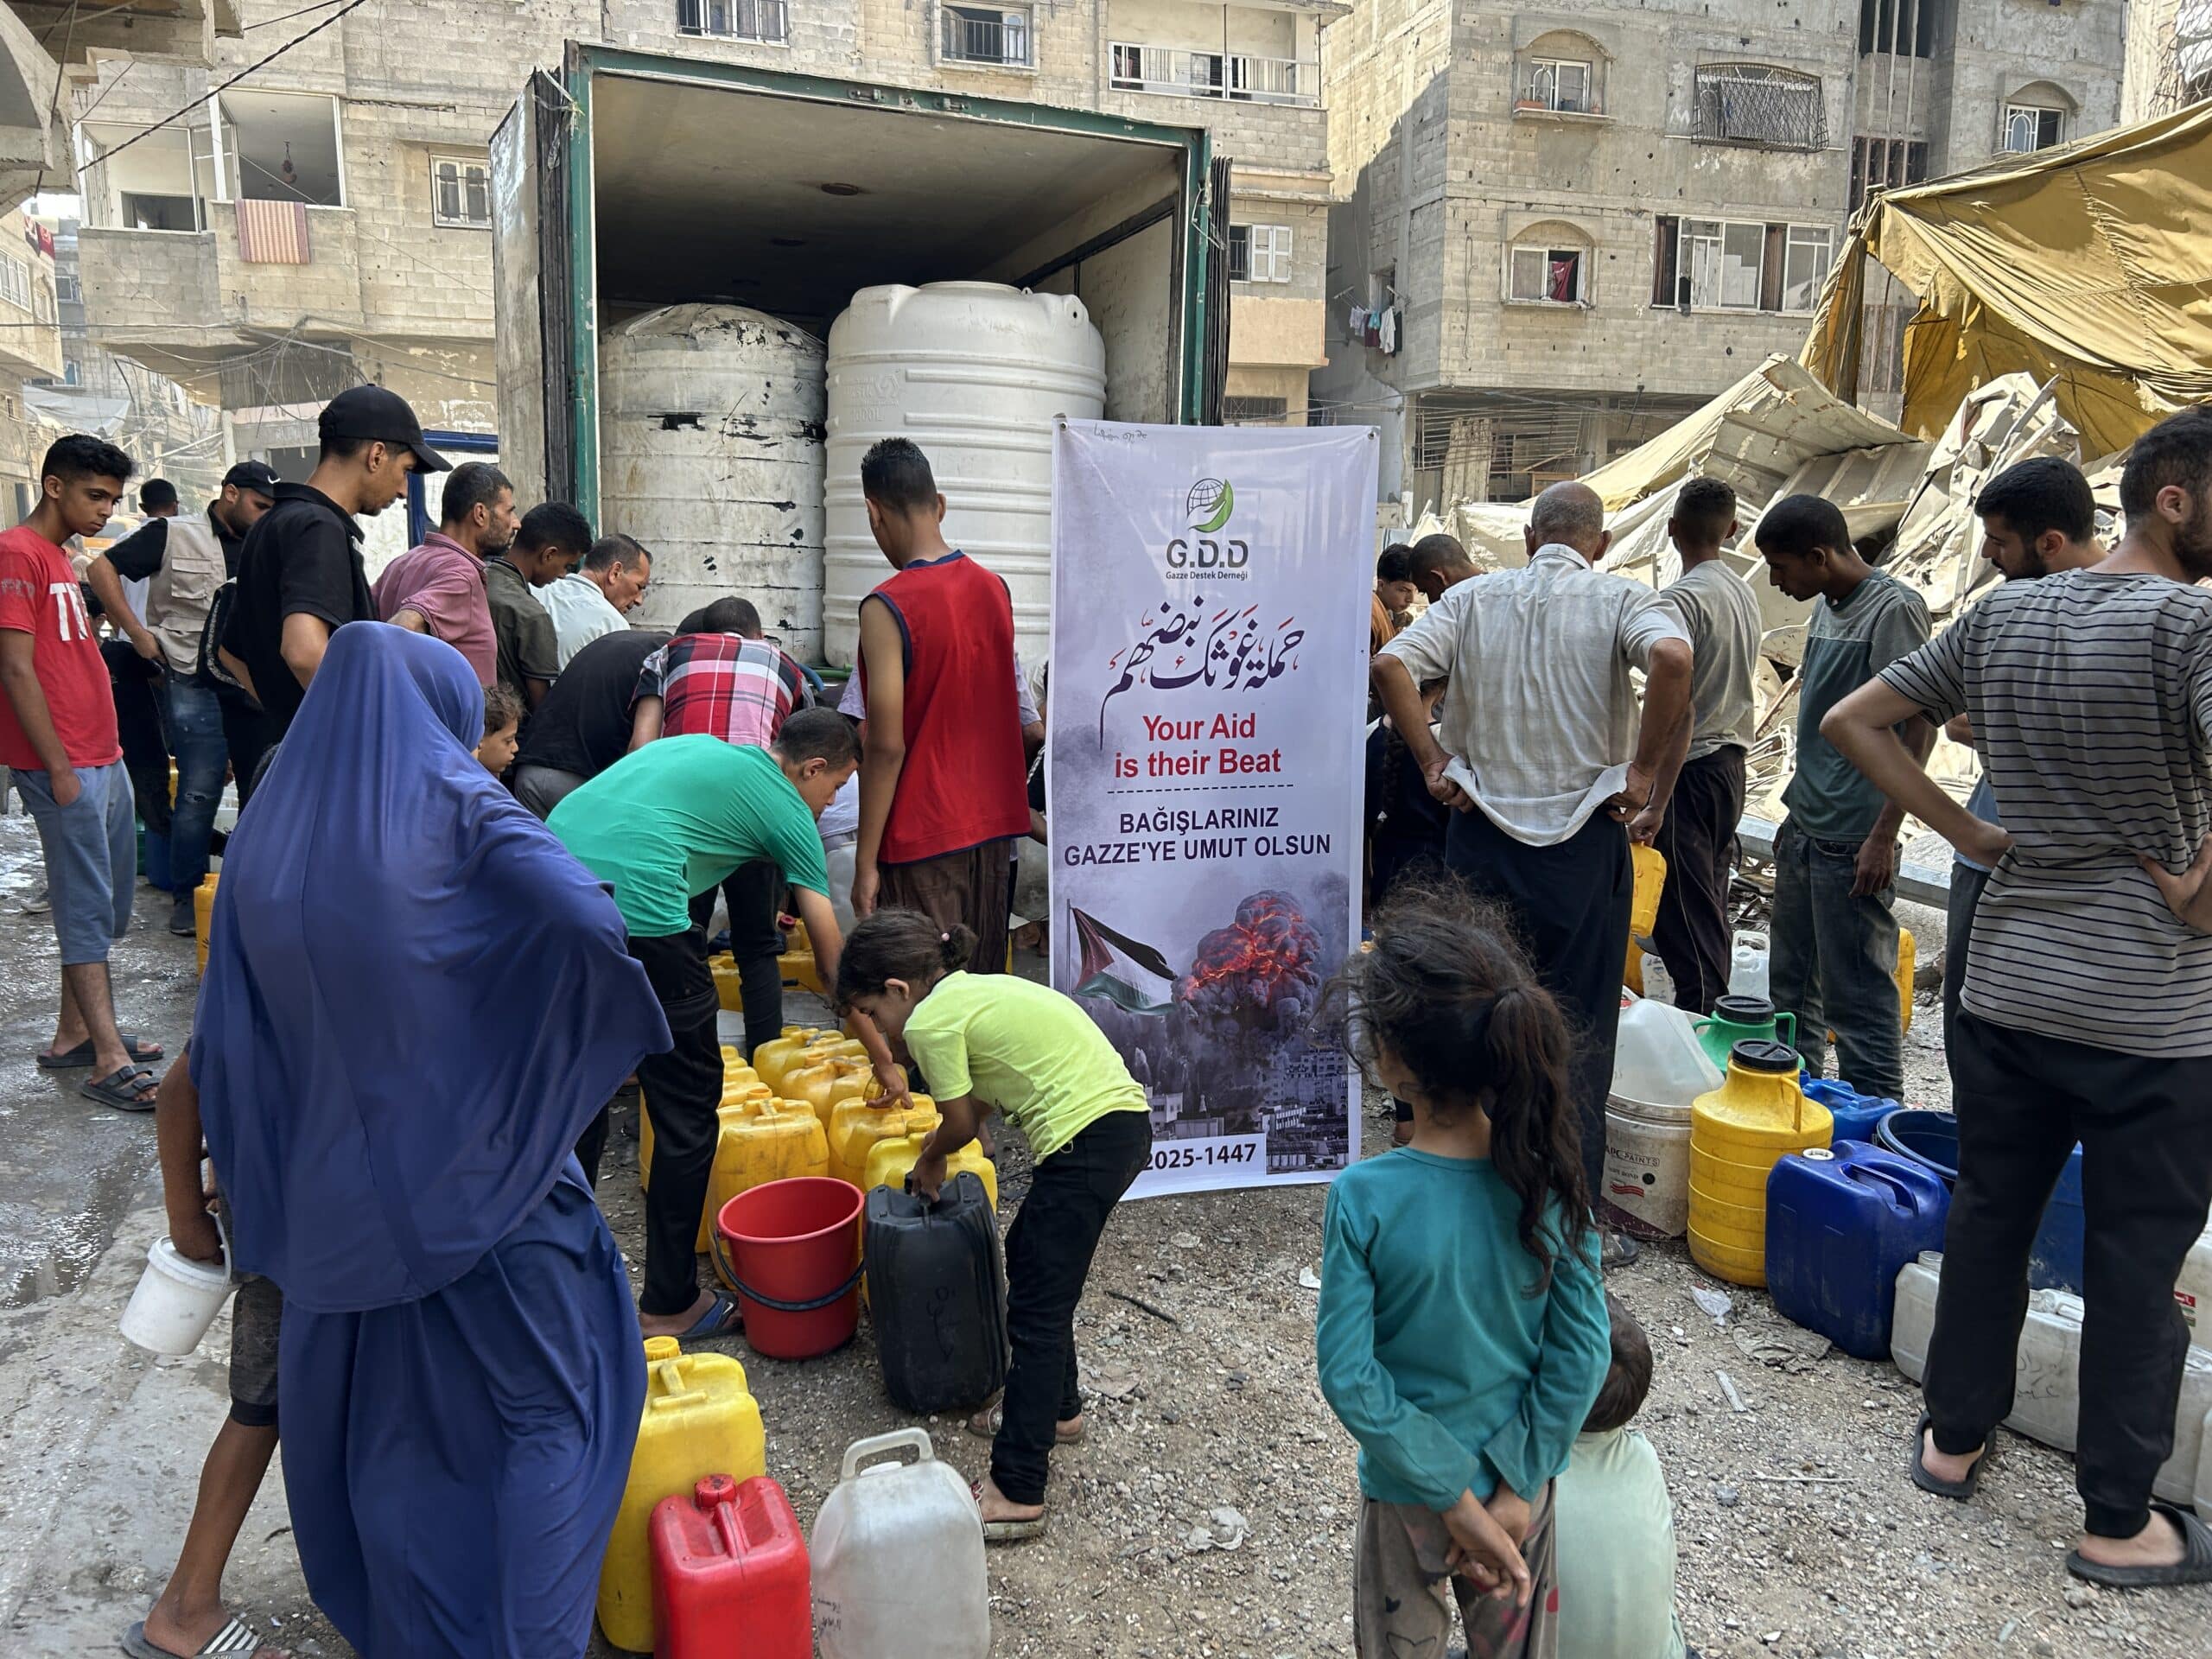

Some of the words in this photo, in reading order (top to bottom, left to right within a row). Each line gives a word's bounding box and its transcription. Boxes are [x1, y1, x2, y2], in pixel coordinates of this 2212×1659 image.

[1166, 538, 1249, 569] G.D.D
[1166, 571, 1189, 580] Gazze
[1190, 571, 1217, 580] Destek
[1217, 571, 1248, 582] Derneği
[1143, 715, 1205, 741] Your
[1210, 712, 1255, 739] Aid
[1116, 752, 1139, 778] is
[1147, 749, 1211, 777] their
[1219, 748, 1281, 773] Beat
[1120, 806, 1279, 836] BAĞIŞLARINIZ
[1065, 841, 1176, 867] GAZZE'YE
[1184, 837, 1247, 860] UMUT
[1255, 834, 1331, 856] OLSUN
[1624, 1152, 1659, 1167] PAINTS
